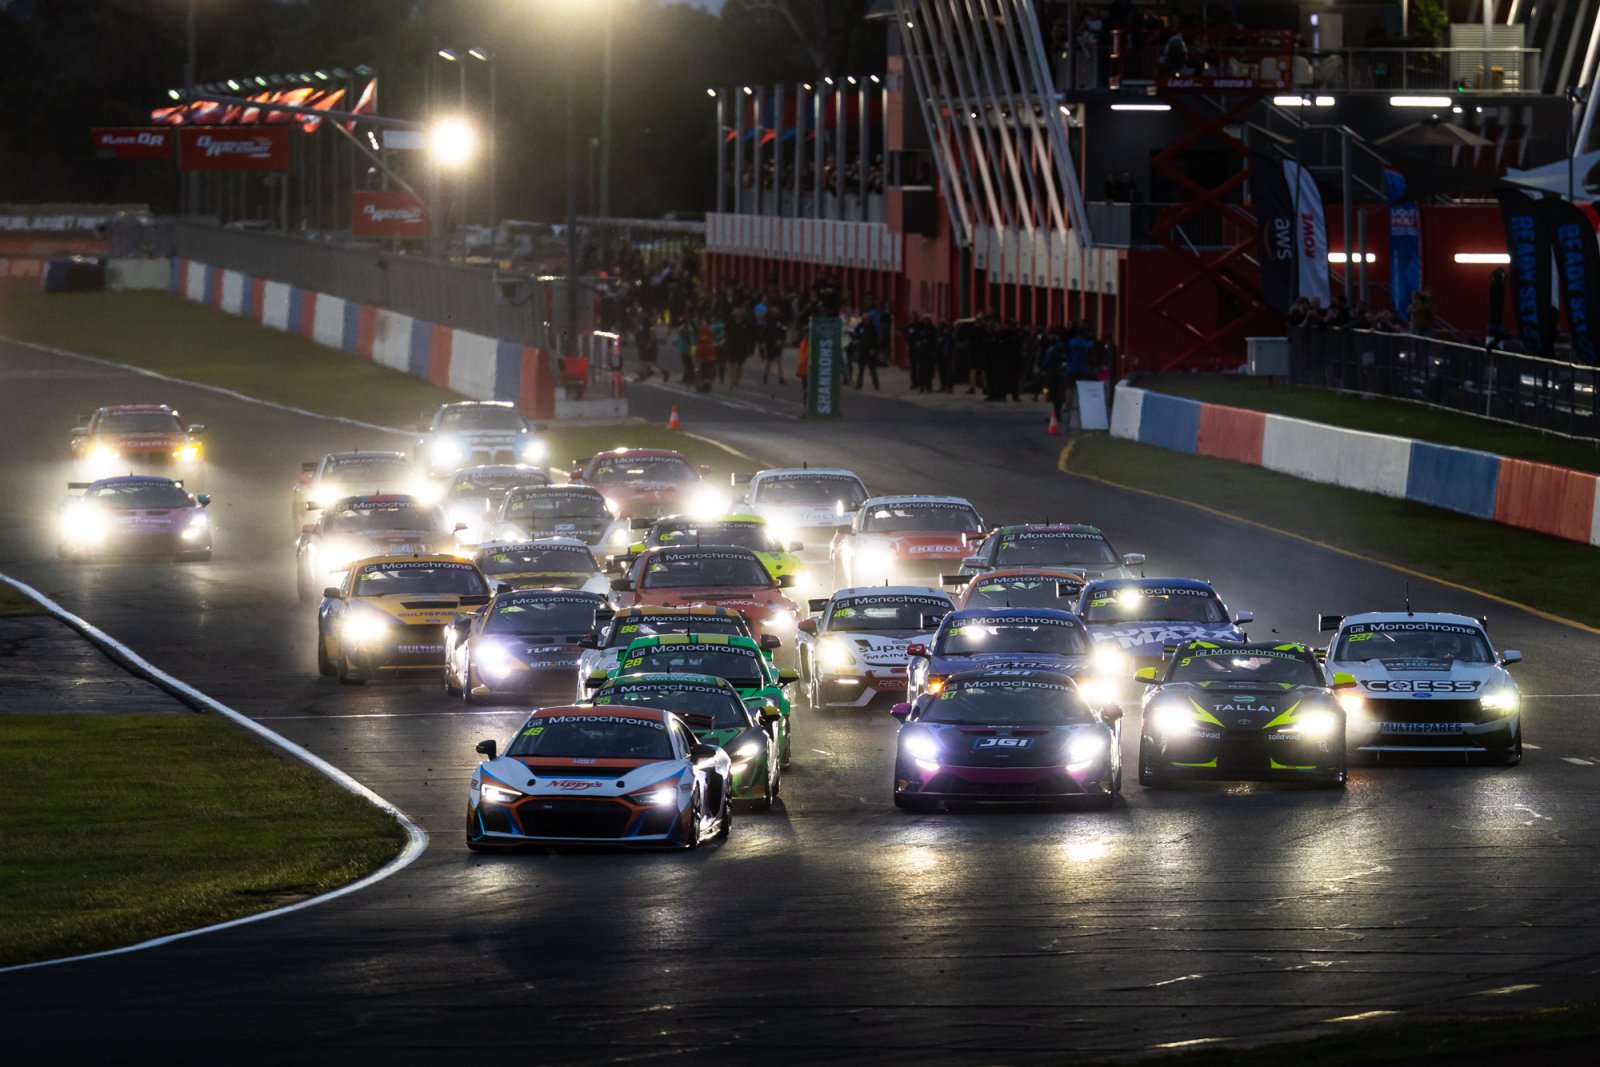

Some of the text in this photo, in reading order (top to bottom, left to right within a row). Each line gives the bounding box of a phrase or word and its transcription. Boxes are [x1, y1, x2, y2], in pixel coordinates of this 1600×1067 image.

[1274, 217, 1292, 261] aws
[817, 339, 833, 413] SHANNONS
[889, 502, 969, 511] Monochrome
[1020, 532, 1103, 541] Monochrome
[502, 545, 587, 554] Monochrome
[1002, 542, 1009, 550] 7
[665, 552, 755, 561] Monochrome
[382, 562, 473, 571] Monochrome
[993, 576, 1084, 585] Monochrome
[854, 596, 950, 608] Monochrome
[972, 616, 1074, 627] Monochrome
[1370, 622, 1476, 635] Monochrome
[1348, 632, 1374, 642] 227
[651, 644, 756, 657] Monochrome
[1211, 648, 1296, 659] Monochrome
[1180, 657, 1191, 667] 9
[621, 684, 732, 696] Monochrome
[964, 680, 1075, 693] Monochrome
[1213, 704, 1276, 712] TALLAI
[548, 715, 665, 730] Monochrome
[1379, 722, 1463, 733] MULTISPARES
[980, 738, 1028, 748] JGI
[547, 780, 604, 791] Nippy's
